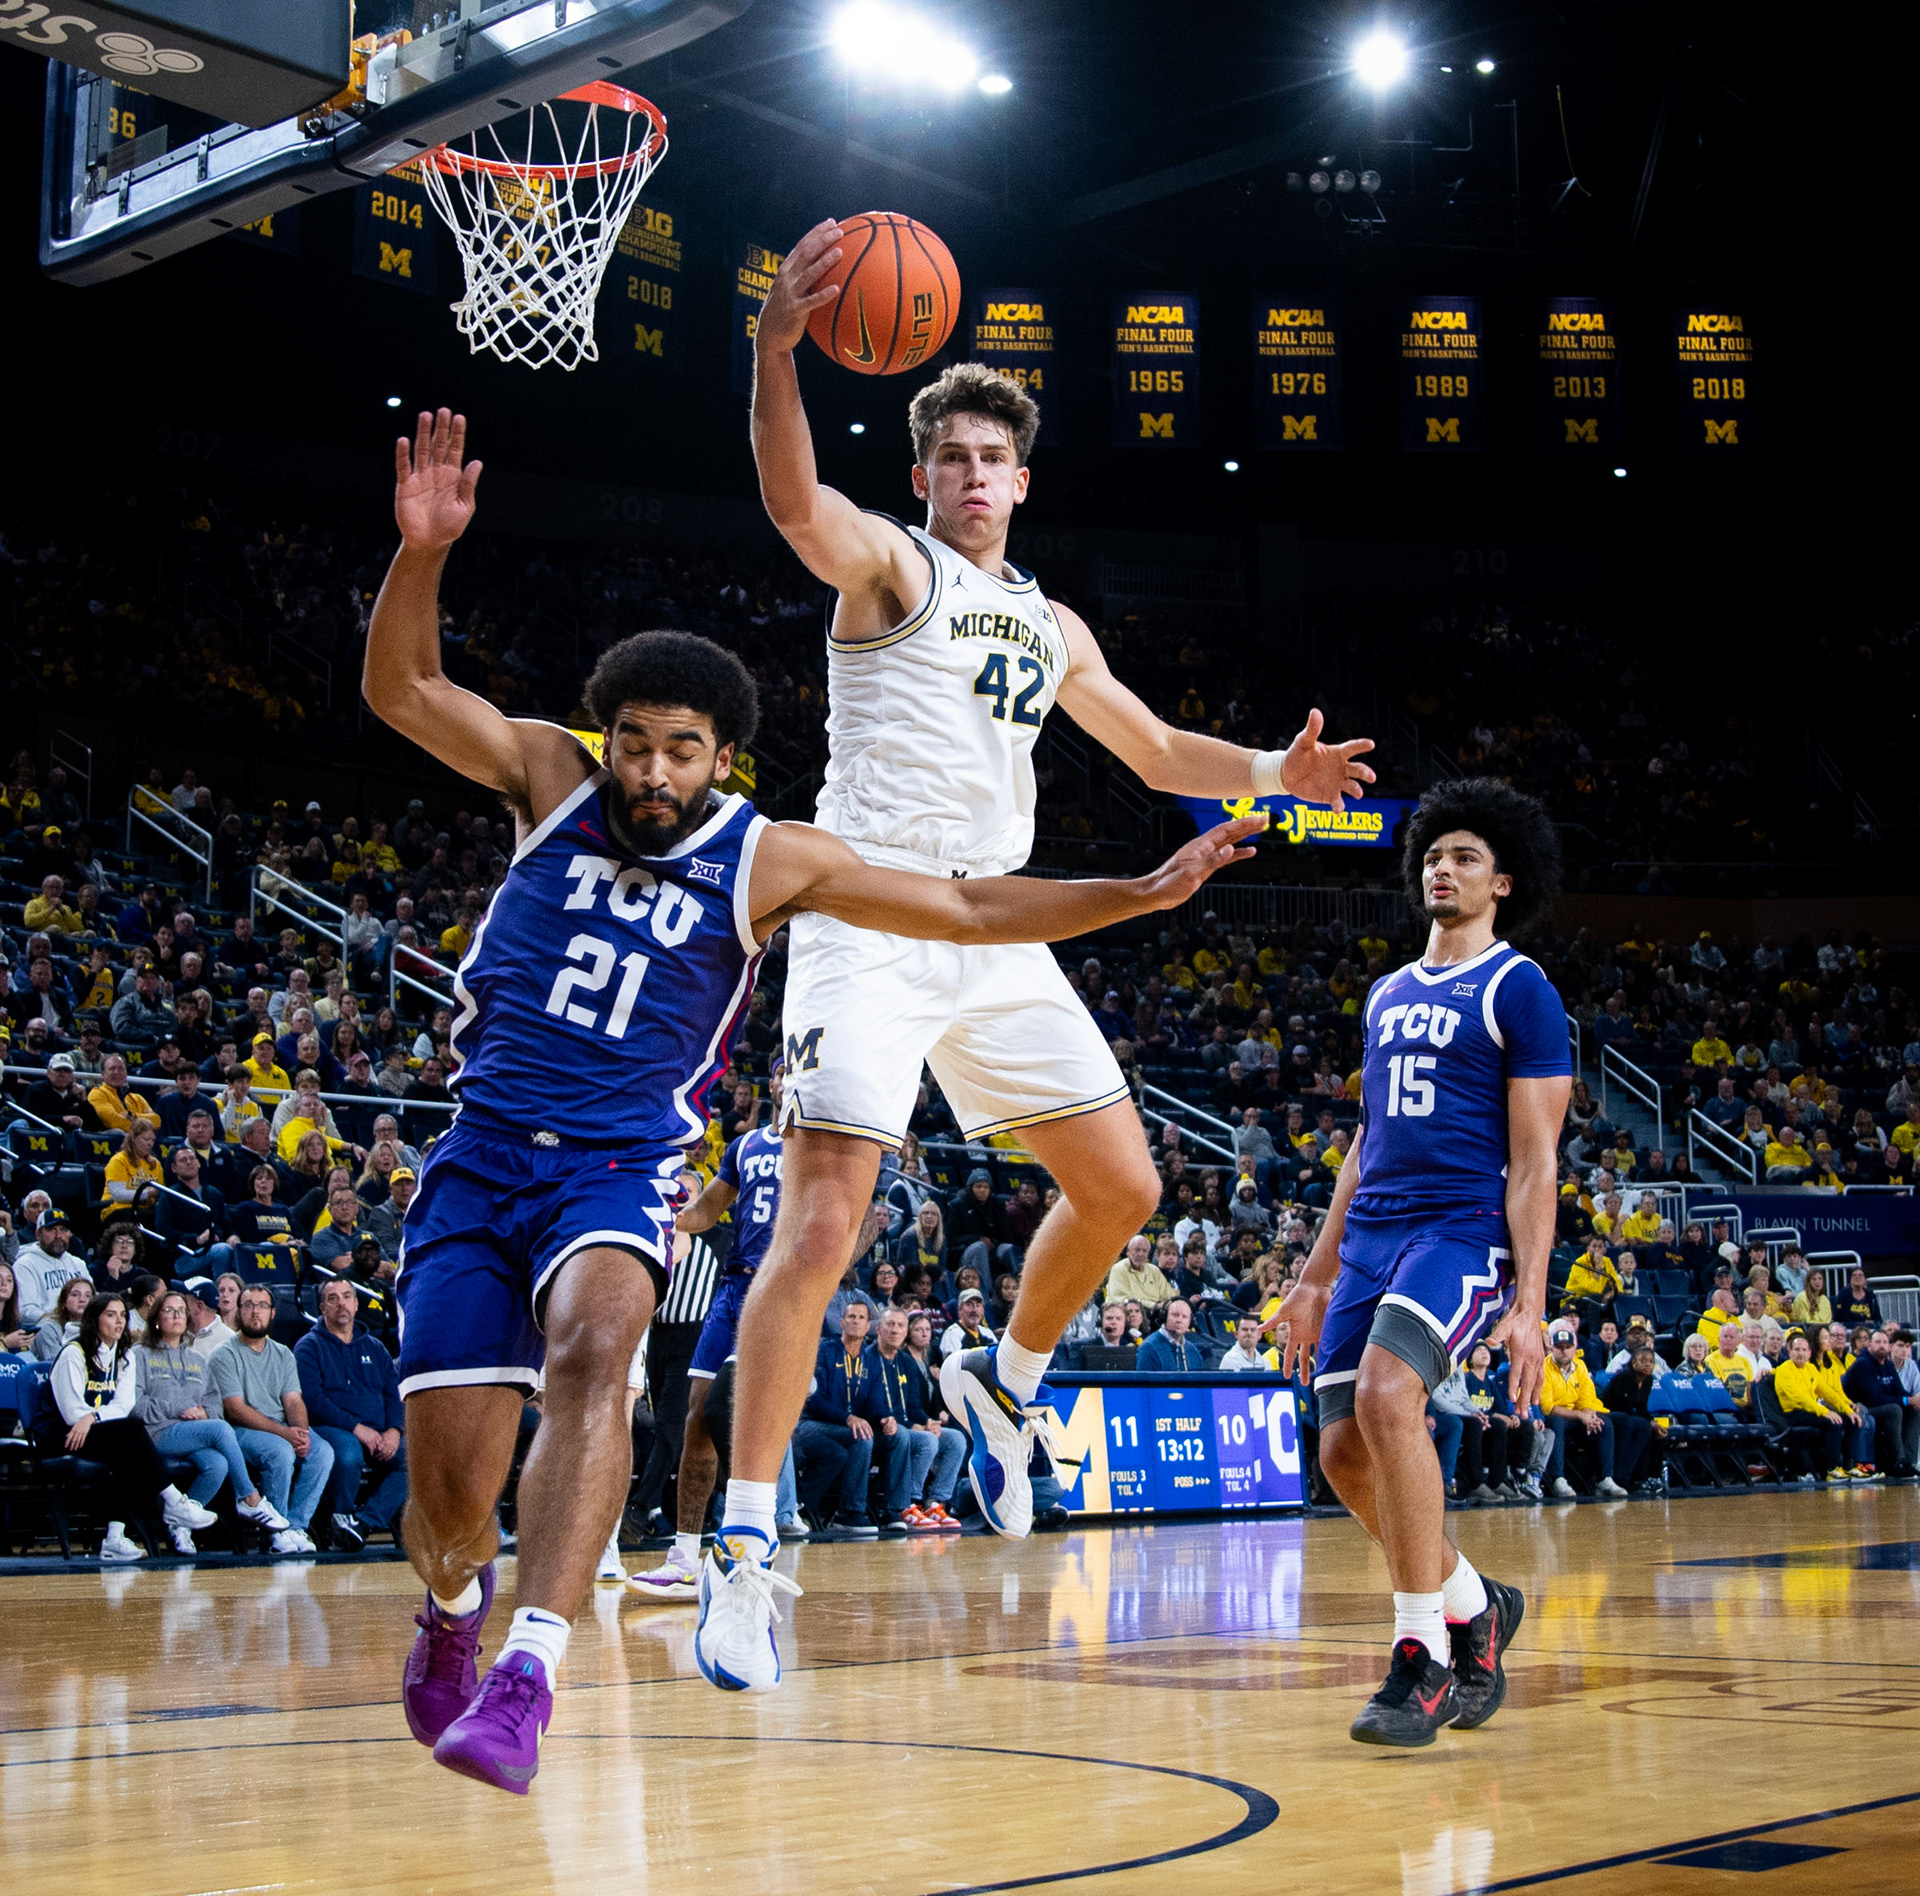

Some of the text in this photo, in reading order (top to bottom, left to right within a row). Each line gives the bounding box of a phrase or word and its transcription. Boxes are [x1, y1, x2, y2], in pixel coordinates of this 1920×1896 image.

[371, 190, 424, 229] 2014
[618, 231, 682, 262] CHAMPIONS
[379, 241, 413, 278] M
[626, 275, 673, 310] 2018
[985, 302, 1044, 322] NCAA
[1126, 306, 1184, 324] NCAA
[1267, 309, 1325, 326] NCAA
[1411, 311, 1467, 329] NCAA
[1548, 313, 1606, 331] NCAA
[1687, 314, 1743, 332] NCAA
[634, 323, 664, 357] M
[902, 292, 932, 367] ELITE
[976, 324, 1054, 341] FINAL FOUR
[1117, 328, 1194, 342] FINAL FOUR
[1259, 330, 1335, 345] FINAL FOUR
[1402, 333, 1478, 348] FINAL FOUR
[977, 340, 1053, 351] MEN'S BASKETBALL
[1118, 344, 1194, 354] MEN'S BASKETBALL
[1259, 346, 1336, 356] MEN'S BASKETBALL
[1540, 334, 1616, 349] FINAL FOUR
[1678, 336, 1753, 351] FINAL FOUR
[1402, 349, 1478, 360] MEN'S BASKETBALL
[1540, 351, 1615, 361] MEN'S BASKETBALL
[1679, 352, 1753, 362] MEN'S BASKETBALL
[998, 367, 1043, 390] 964
[1129, 370, 1185, 393] 1965
[1271, 372, 1327, 395] 1976
[1415, 375, 1469, 397] 1989
[1554, 376, 1606, 398] 2013
[1692, 377, 1745, 399] 2018
[1139, 412, 1175, 438] M
[1282, 415, 1318, 440] M
[1425, 417, 1460, 442] M
[1564, 418, 1599, 443] M
[1703, 419, 1739, 444] M
[949, 612, 1055, 673] MICHIGAN
[973, 652, 1046, 730] 42
[1288, 804, 1383, 843] JEWELERS
[562, 854, 705, 949] TCU
[545, 932, 651, 1040] 21
[1378, 1003, 1462, 1049] TCU
[785, 1025, 826, 1076] M
[1386, 1055, 1437, 1117] 15
[29, 1136, 49, 1151] M
[92, 1140, 112, 1156] M
[752, 1186, 774, 1223] 5
[1754, 1217, 1871, 1232] BLAVIN TUNNEL
[255, 1253, 276, 1269] M
[1110, 1415, 1138, 1447] 11
[1155, 1417, 1202, 1432] 1ST HALF
[1218, 1414, 1247, 1445] 10
[1157, 1438, 1205, 1462] 13:12
[1110, 1469, 1147, 1482] FOULS 3
[1174, 1476, 1194, 1488] POSS
[1219, 1466, 1252, 1479] FOULS 4
[1116, 1483, 1143, 1496] TOL 4
[1225, 1480, 1250, 1492] TOL 4
